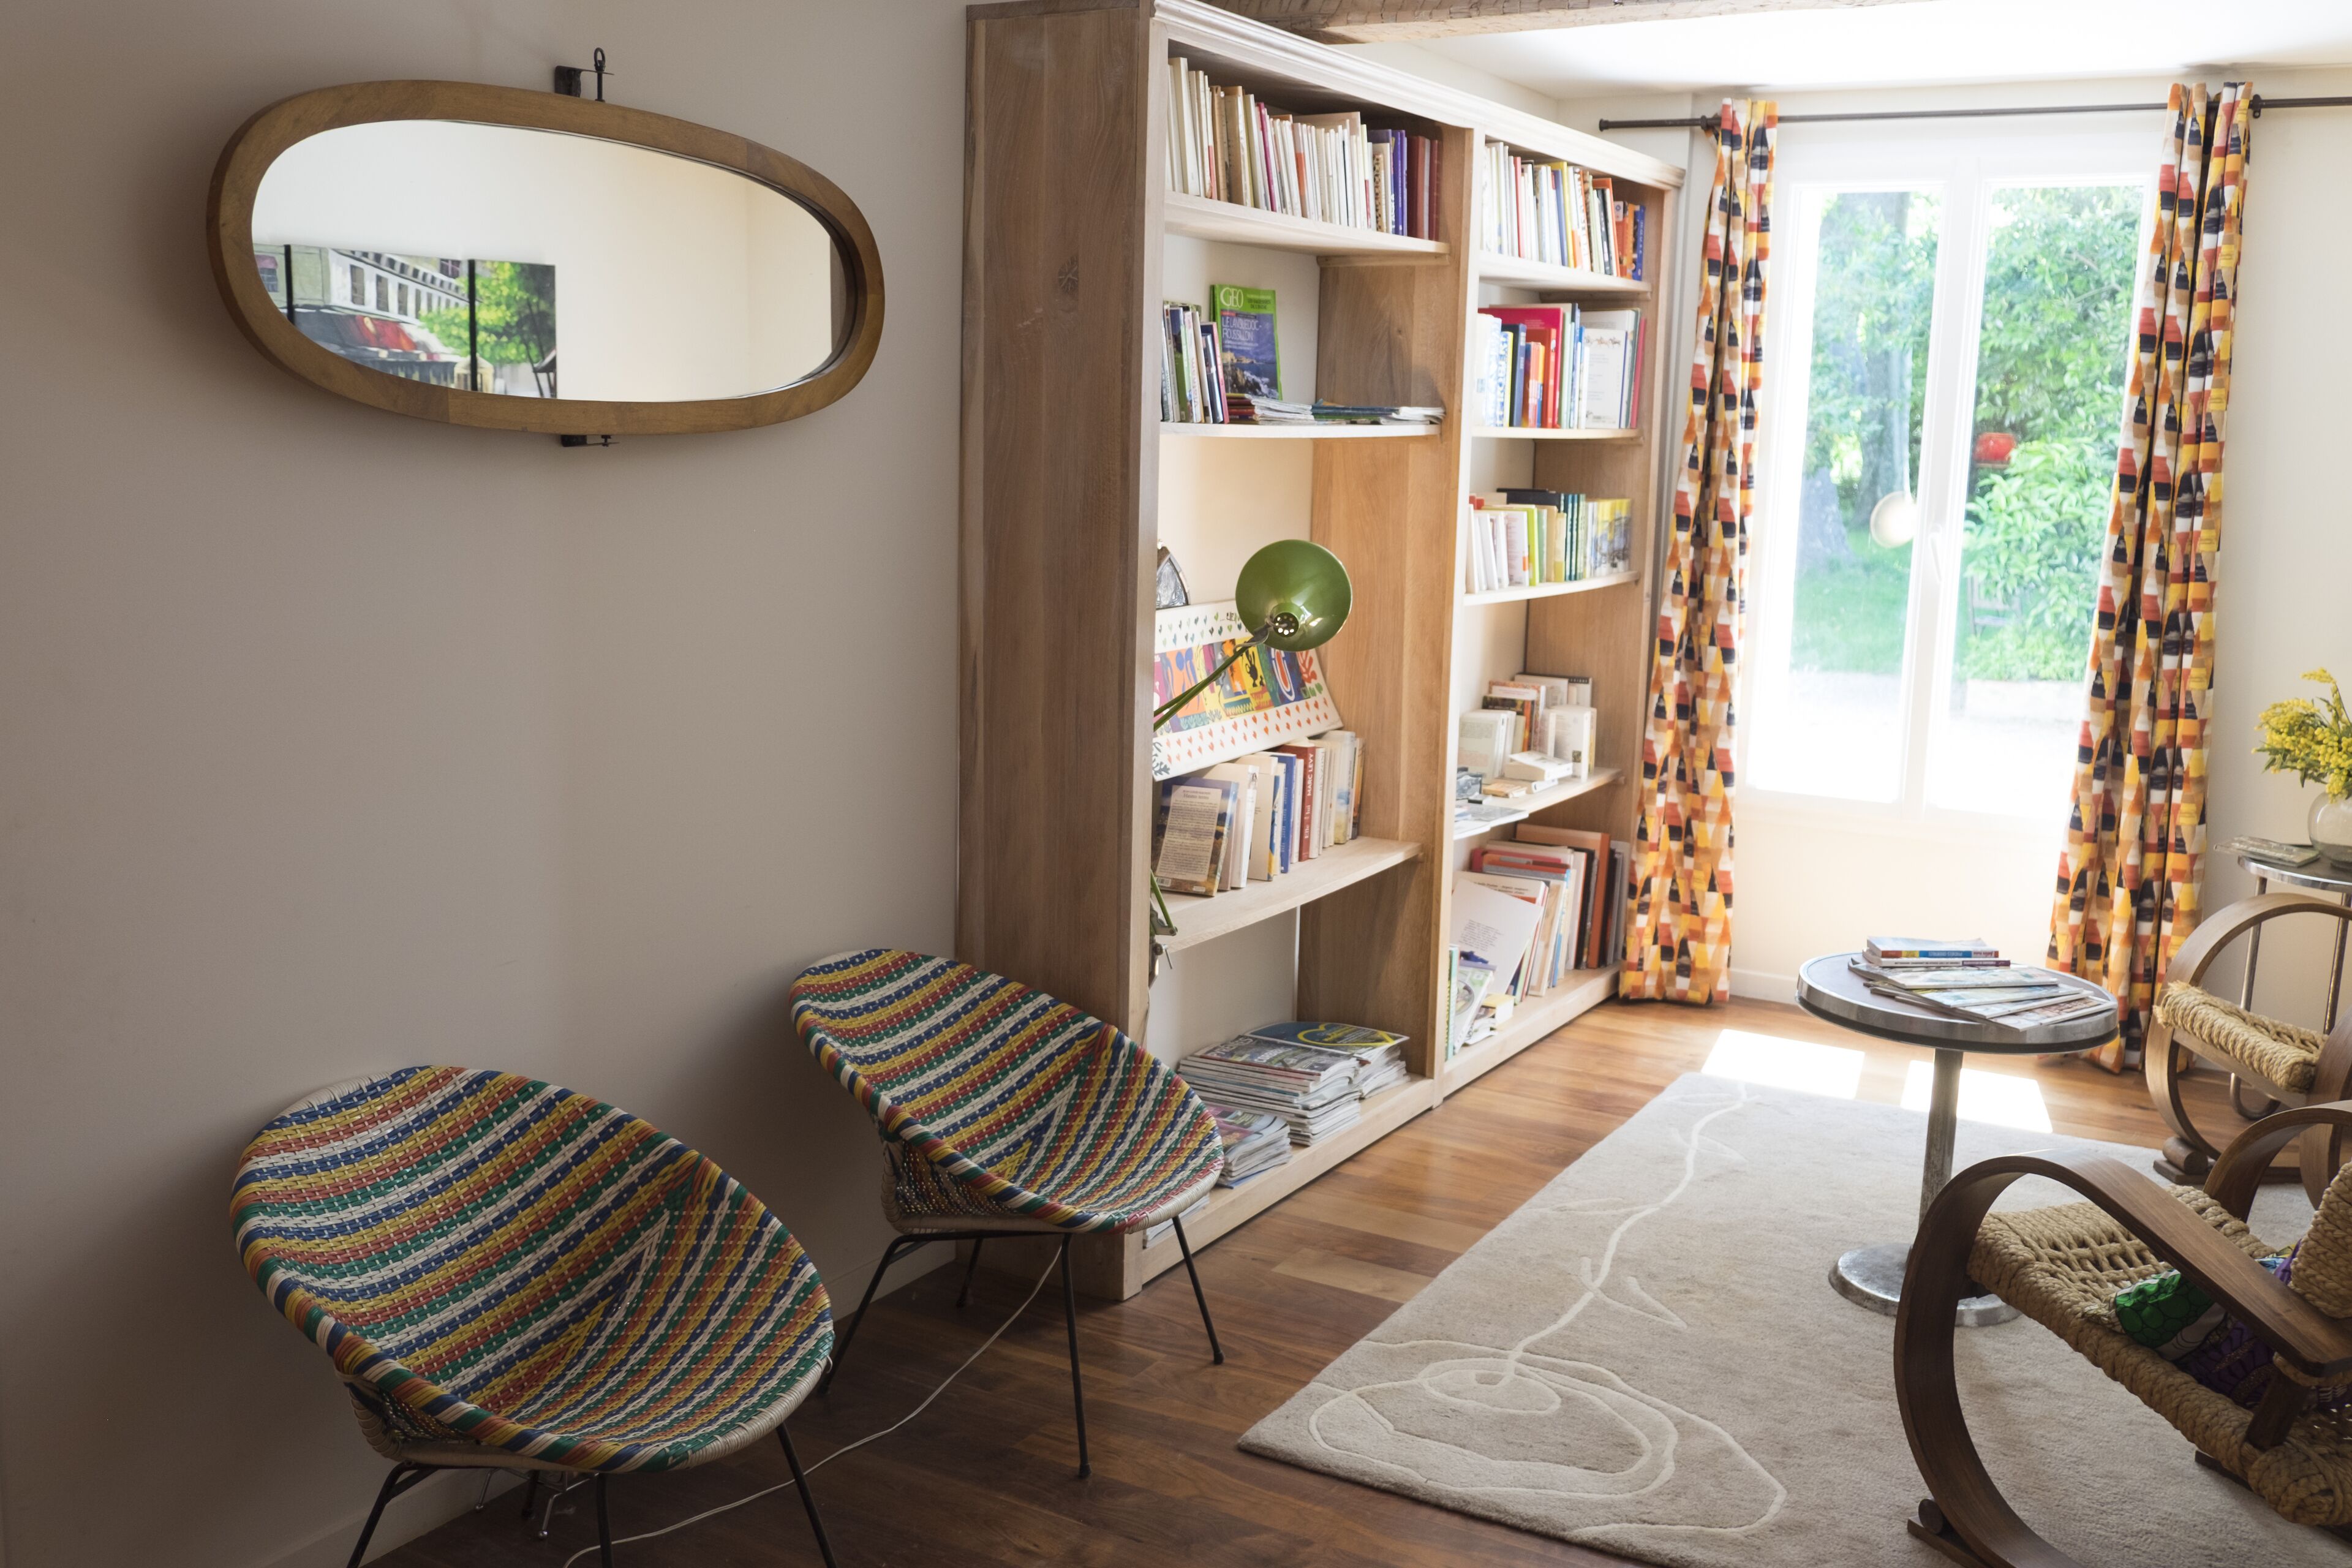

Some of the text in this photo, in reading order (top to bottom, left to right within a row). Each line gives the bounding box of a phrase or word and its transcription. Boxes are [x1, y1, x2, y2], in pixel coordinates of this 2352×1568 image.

[1220, 287, 1243, 308] GEO
[1222, 317, 1230, 327] LE
[1223, 328, 1253, 341] ROUSSILLON
